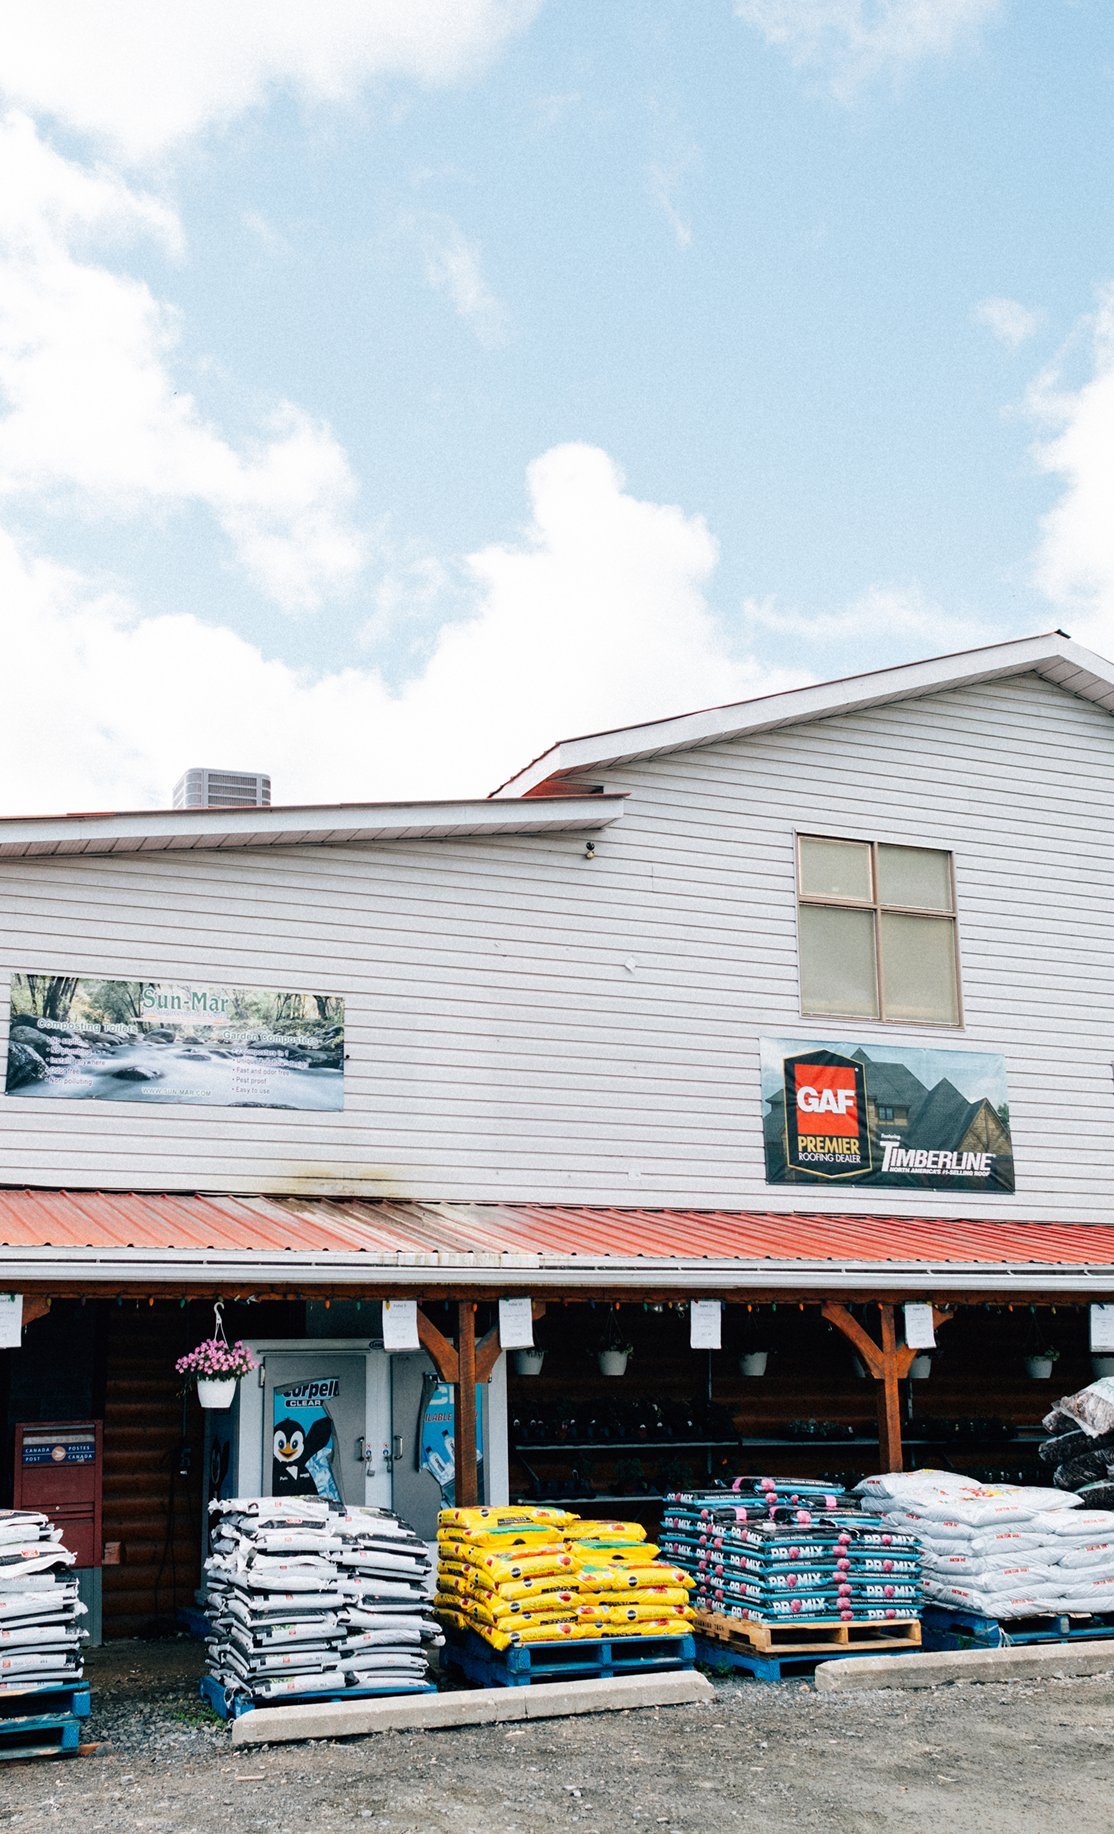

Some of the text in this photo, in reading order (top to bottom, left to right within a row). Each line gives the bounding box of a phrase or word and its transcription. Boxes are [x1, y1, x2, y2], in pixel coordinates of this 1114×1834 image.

[143, 989, 229, 1012] Sun-Mar
[37, 1018, 138, 1033] Composting Toilets
[223, 1030, 318, 1045] Garden Composters
[796, 1085, 856, 1115] GAF
[798, 1135, 861, 1155] PREMIER
[798, 1152, 861, 1164] ROOFING DEALER
